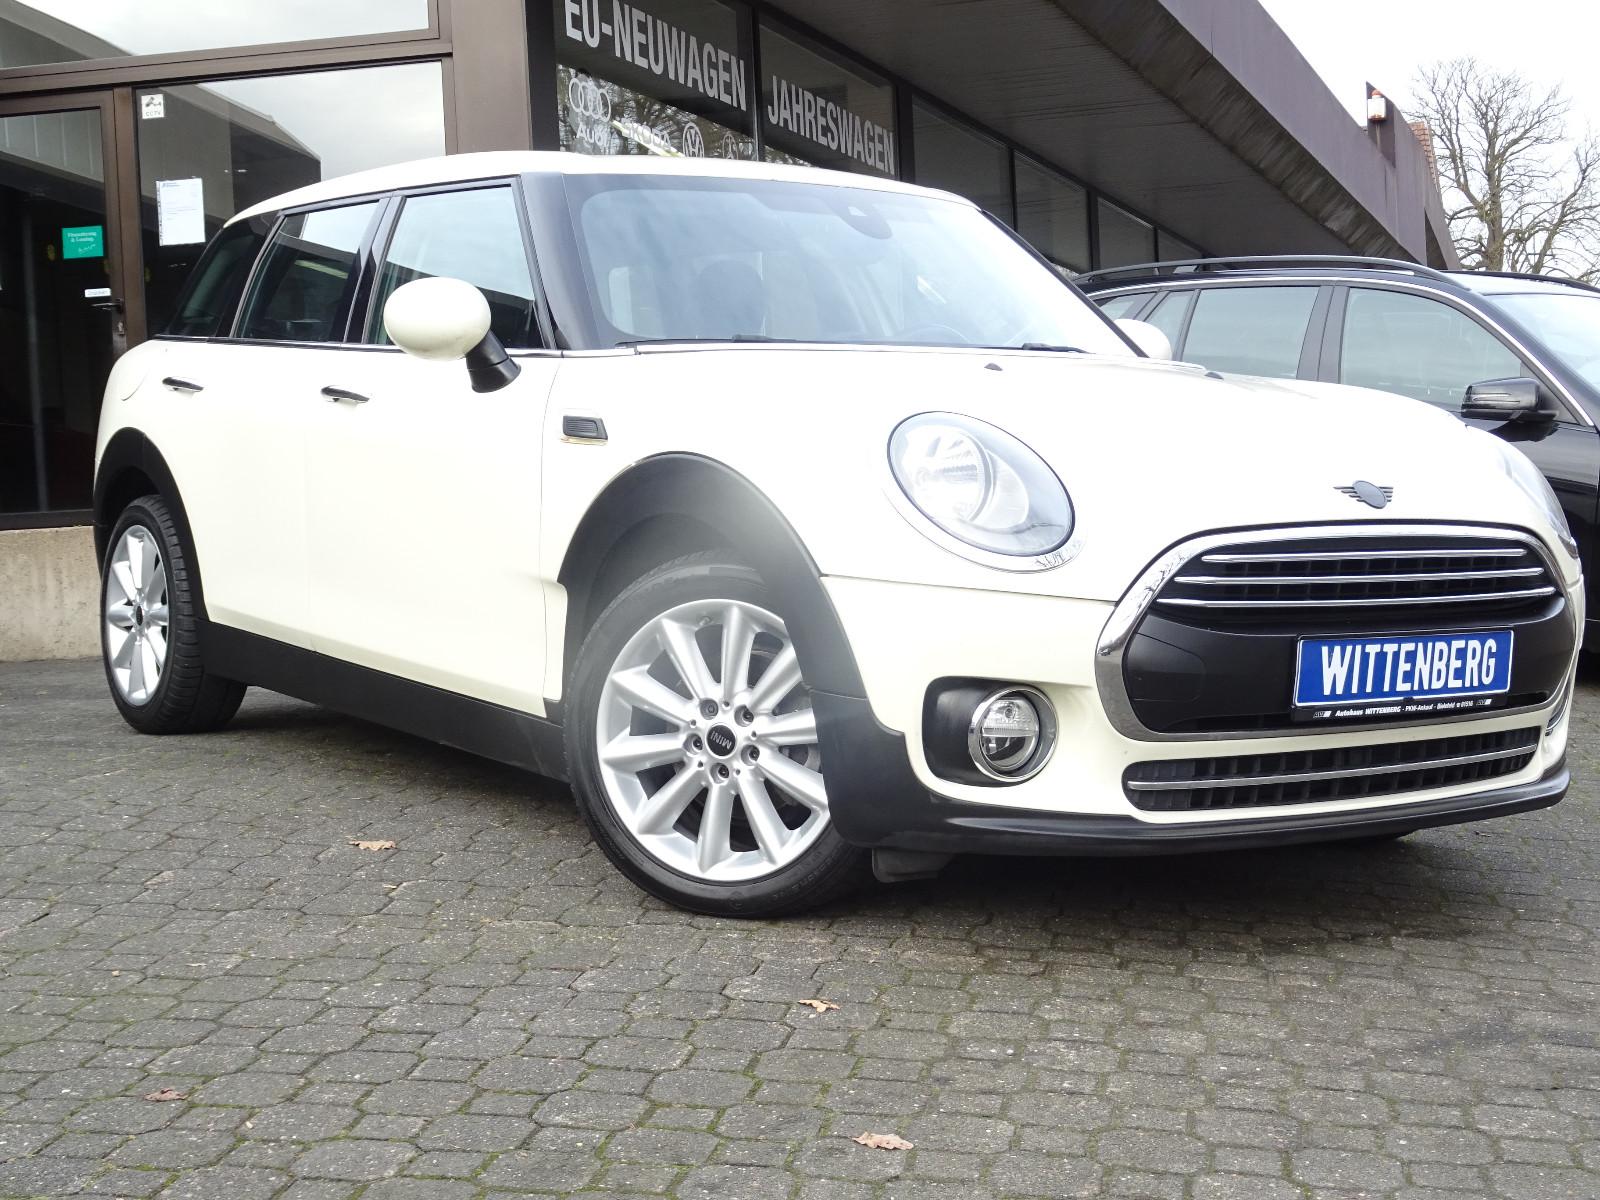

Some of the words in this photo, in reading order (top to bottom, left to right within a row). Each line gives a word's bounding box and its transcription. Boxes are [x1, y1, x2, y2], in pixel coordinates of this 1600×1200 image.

[565, 0, 746, 111] EU-NEUWAGEN
[768, 75, 895, 175] JAHRESWAGEN
[1321, 638, 1497, 695] WITTENBERG
[711, 730, 731, 749] MINI
[1335, 708, 1364, 717] Autohaus
[1365, 706, 1401, 715] WITTENBERG
